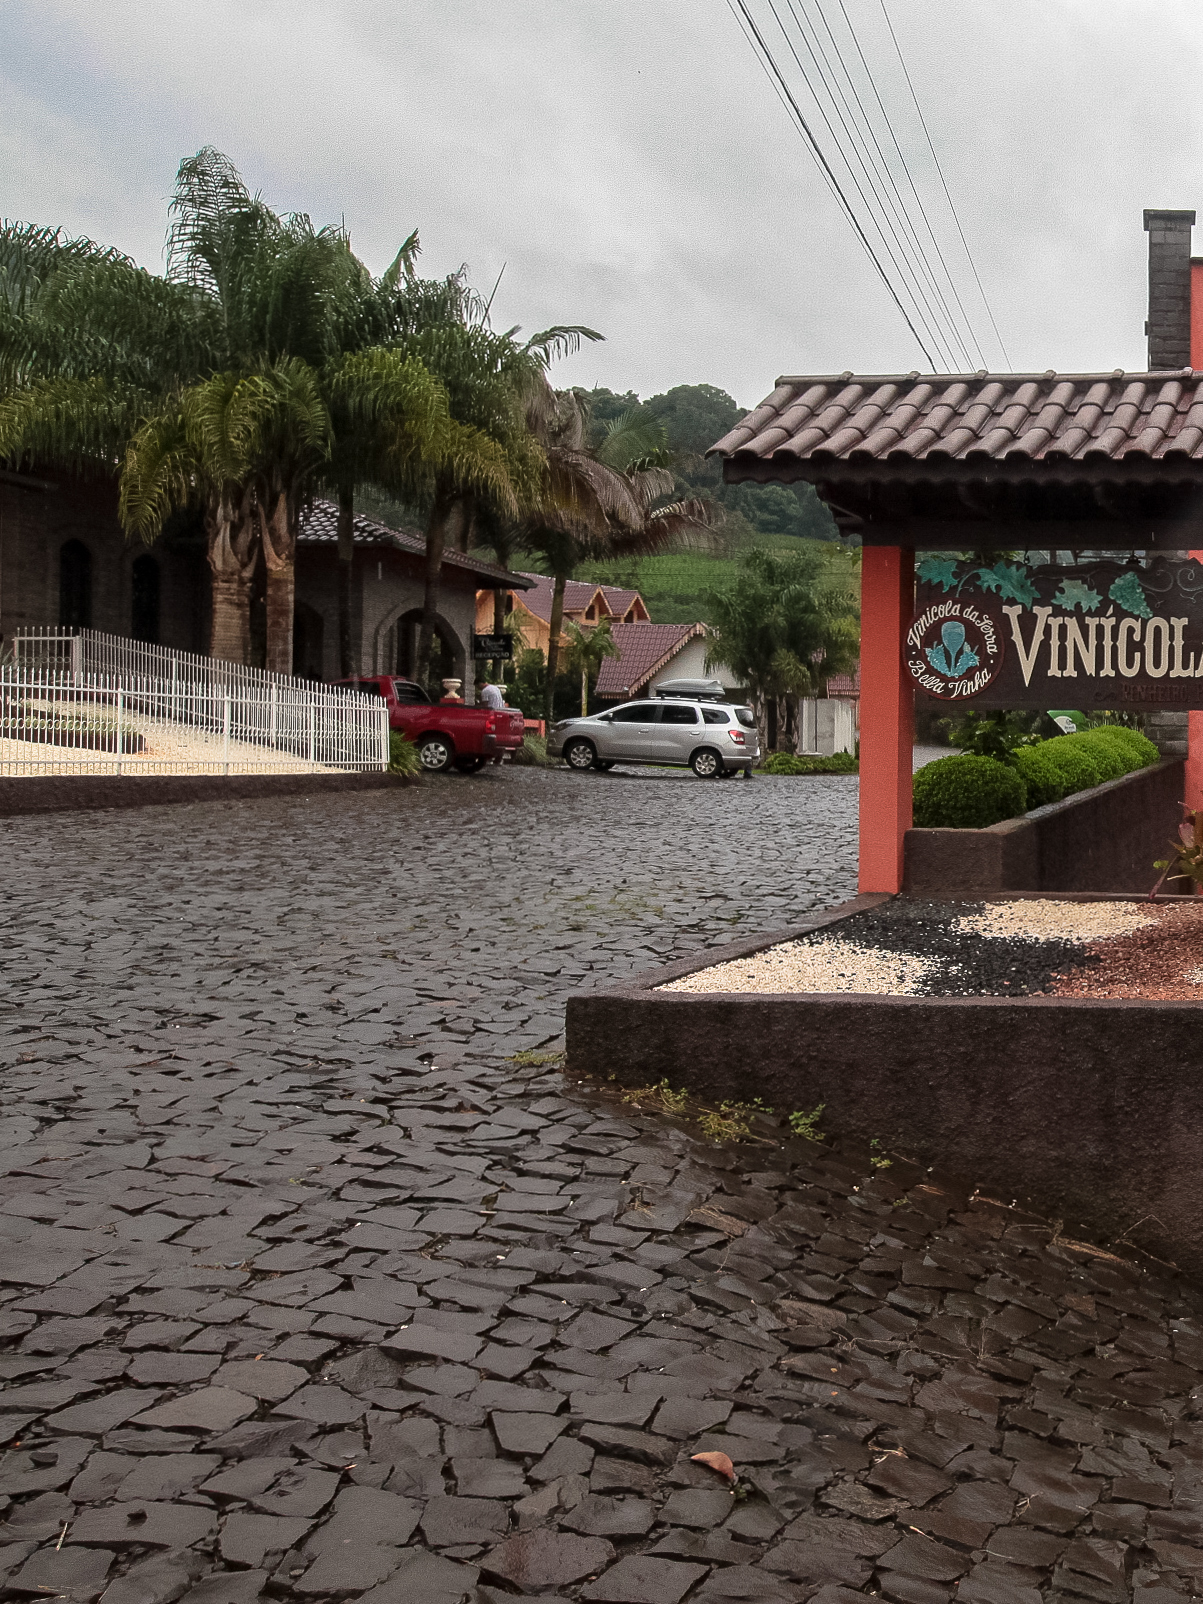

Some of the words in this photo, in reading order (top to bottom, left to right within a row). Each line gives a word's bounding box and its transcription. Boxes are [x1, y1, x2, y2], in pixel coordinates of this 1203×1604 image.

[963, 605, 980, 623] da
[976, 614, 998, 656] Serra
[908, 660, 946, 693] Bella
[948, 668, 992, 698] Vinha
